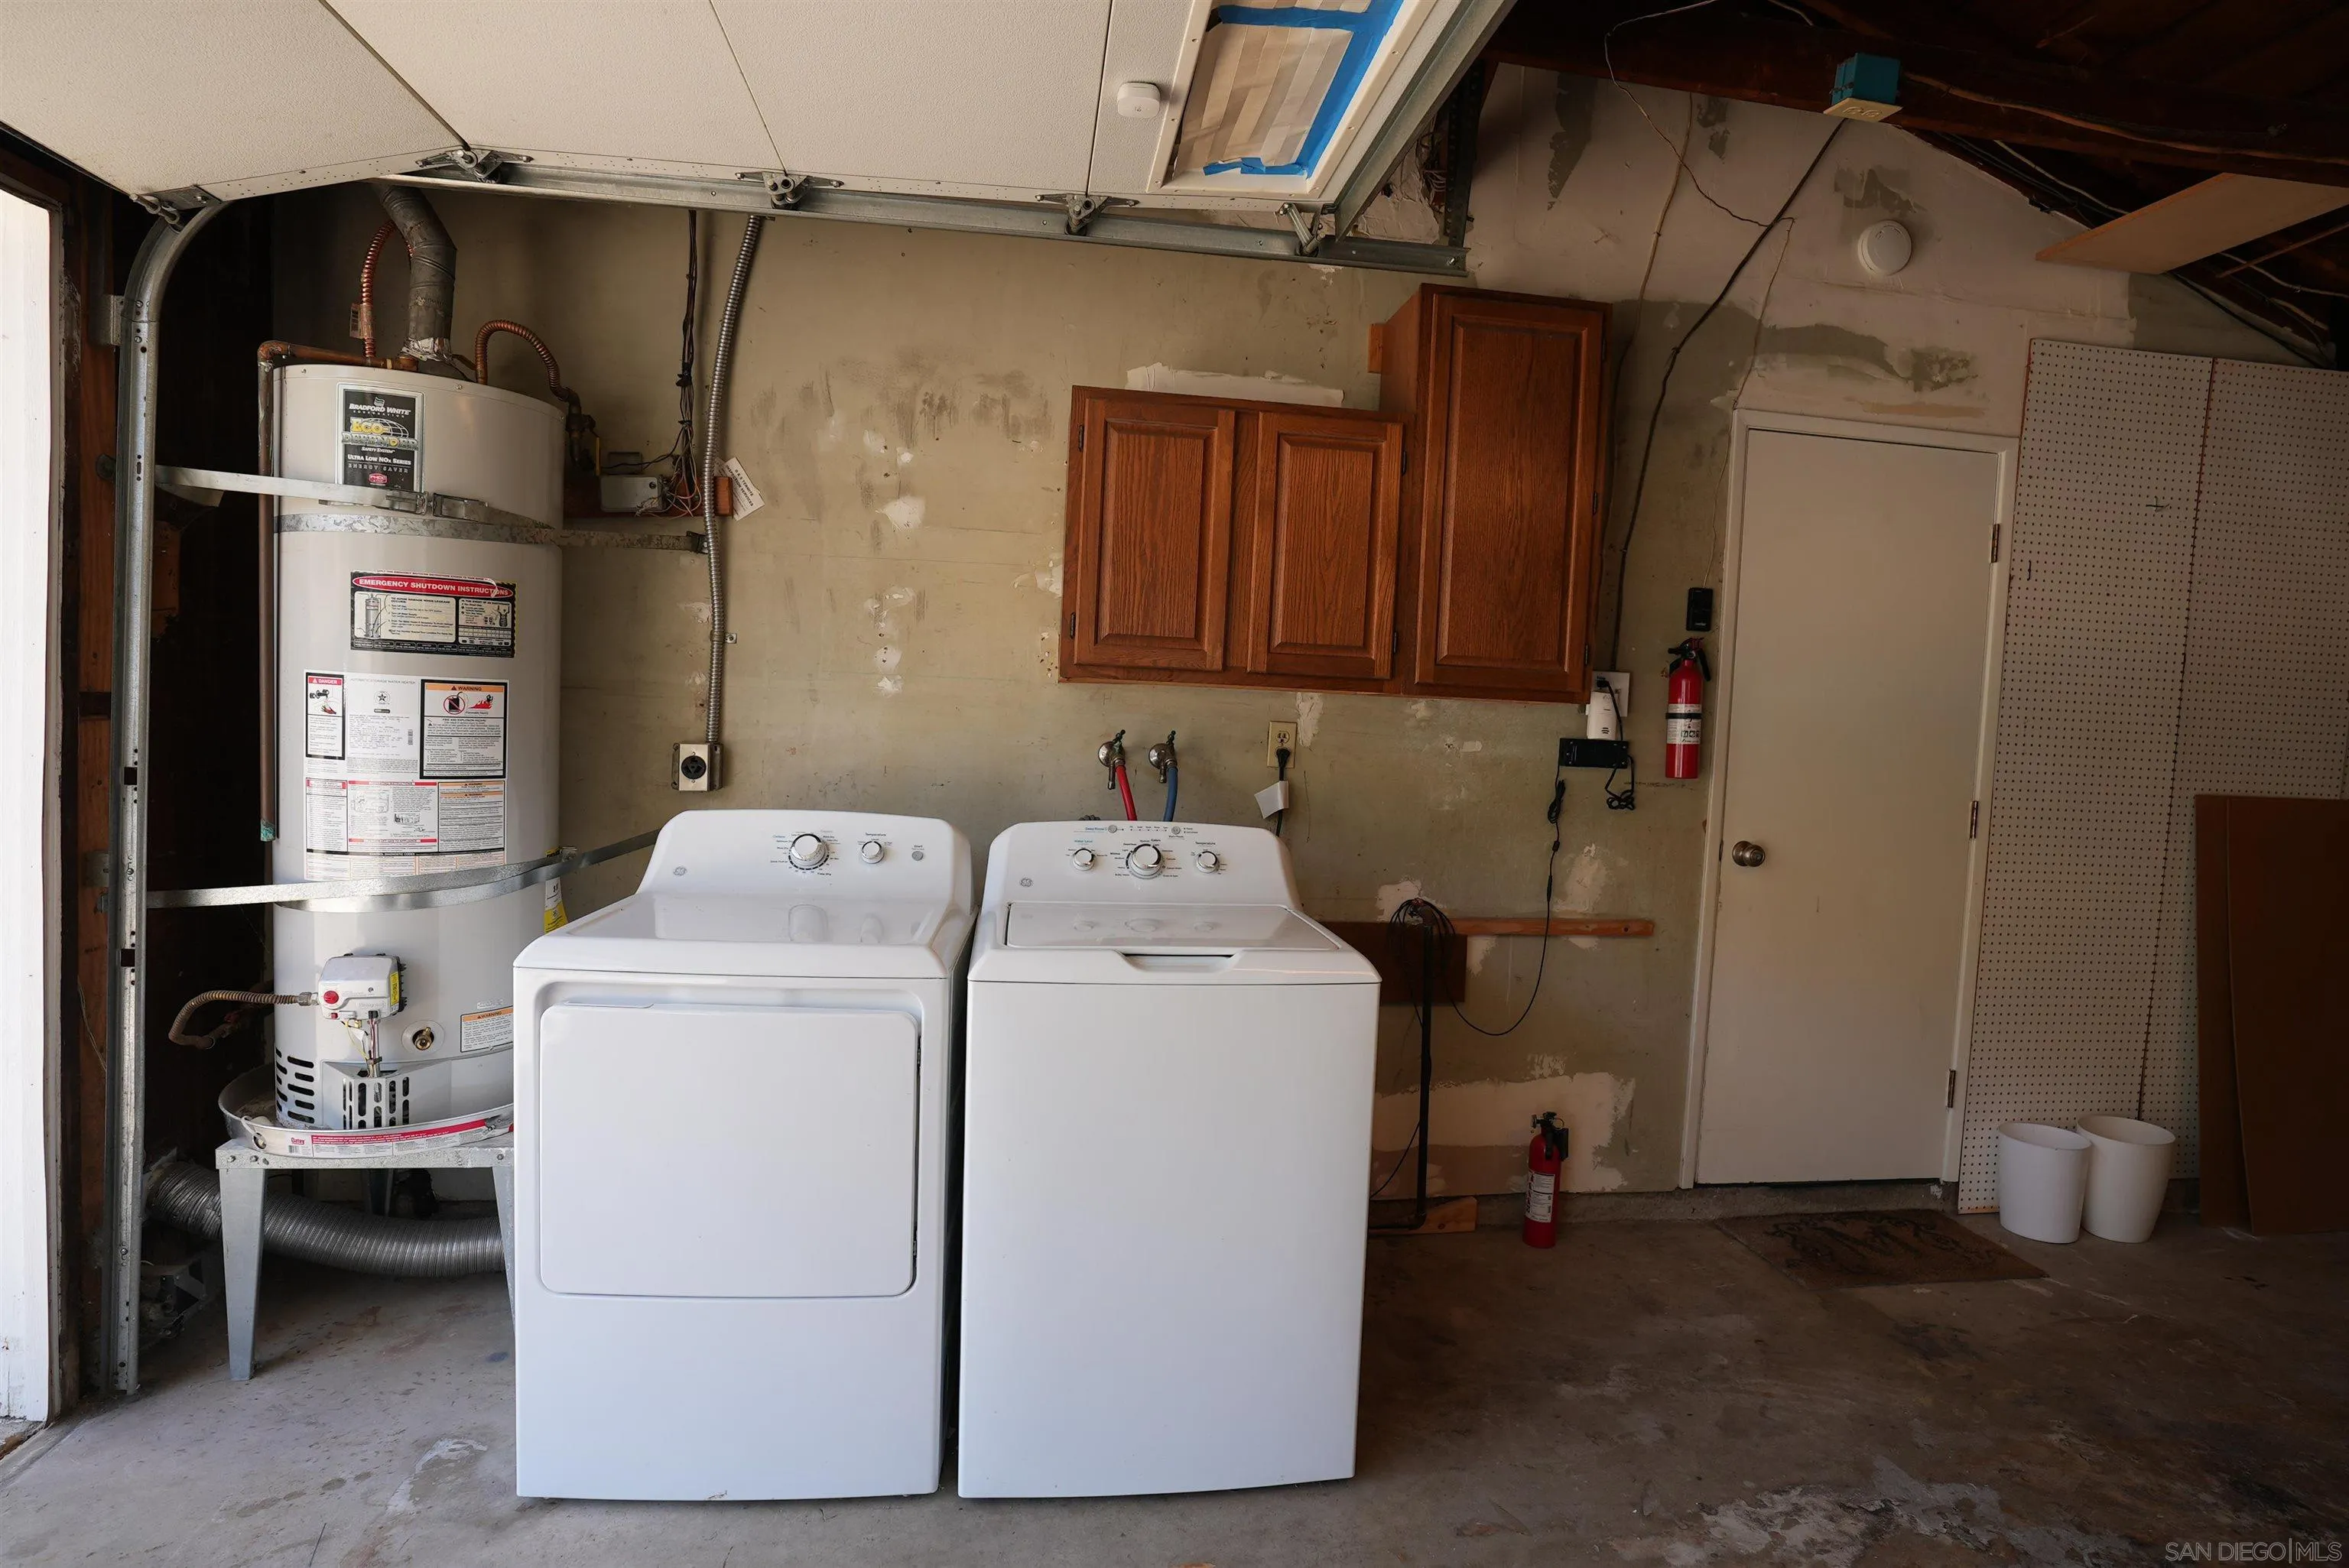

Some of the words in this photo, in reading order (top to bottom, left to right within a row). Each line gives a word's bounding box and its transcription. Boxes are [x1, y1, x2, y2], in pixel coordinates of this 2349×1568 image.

[349, 403, 385, 413] BRADFORD
[386, 407, 411, 415] WHITE
[348, 463, 379, 471] ENERGY
[726, 465, 741, 488] INSPECTION
[741, 488, 754, 506] SERVICES
[742, 480, 754, 496] TERMITE
[359, 579, 408, 588] EMERGENCY
[411, 582, 456, 591] SHUTDOWN
[457, 586, 508, 596] INSTRUCTONS
